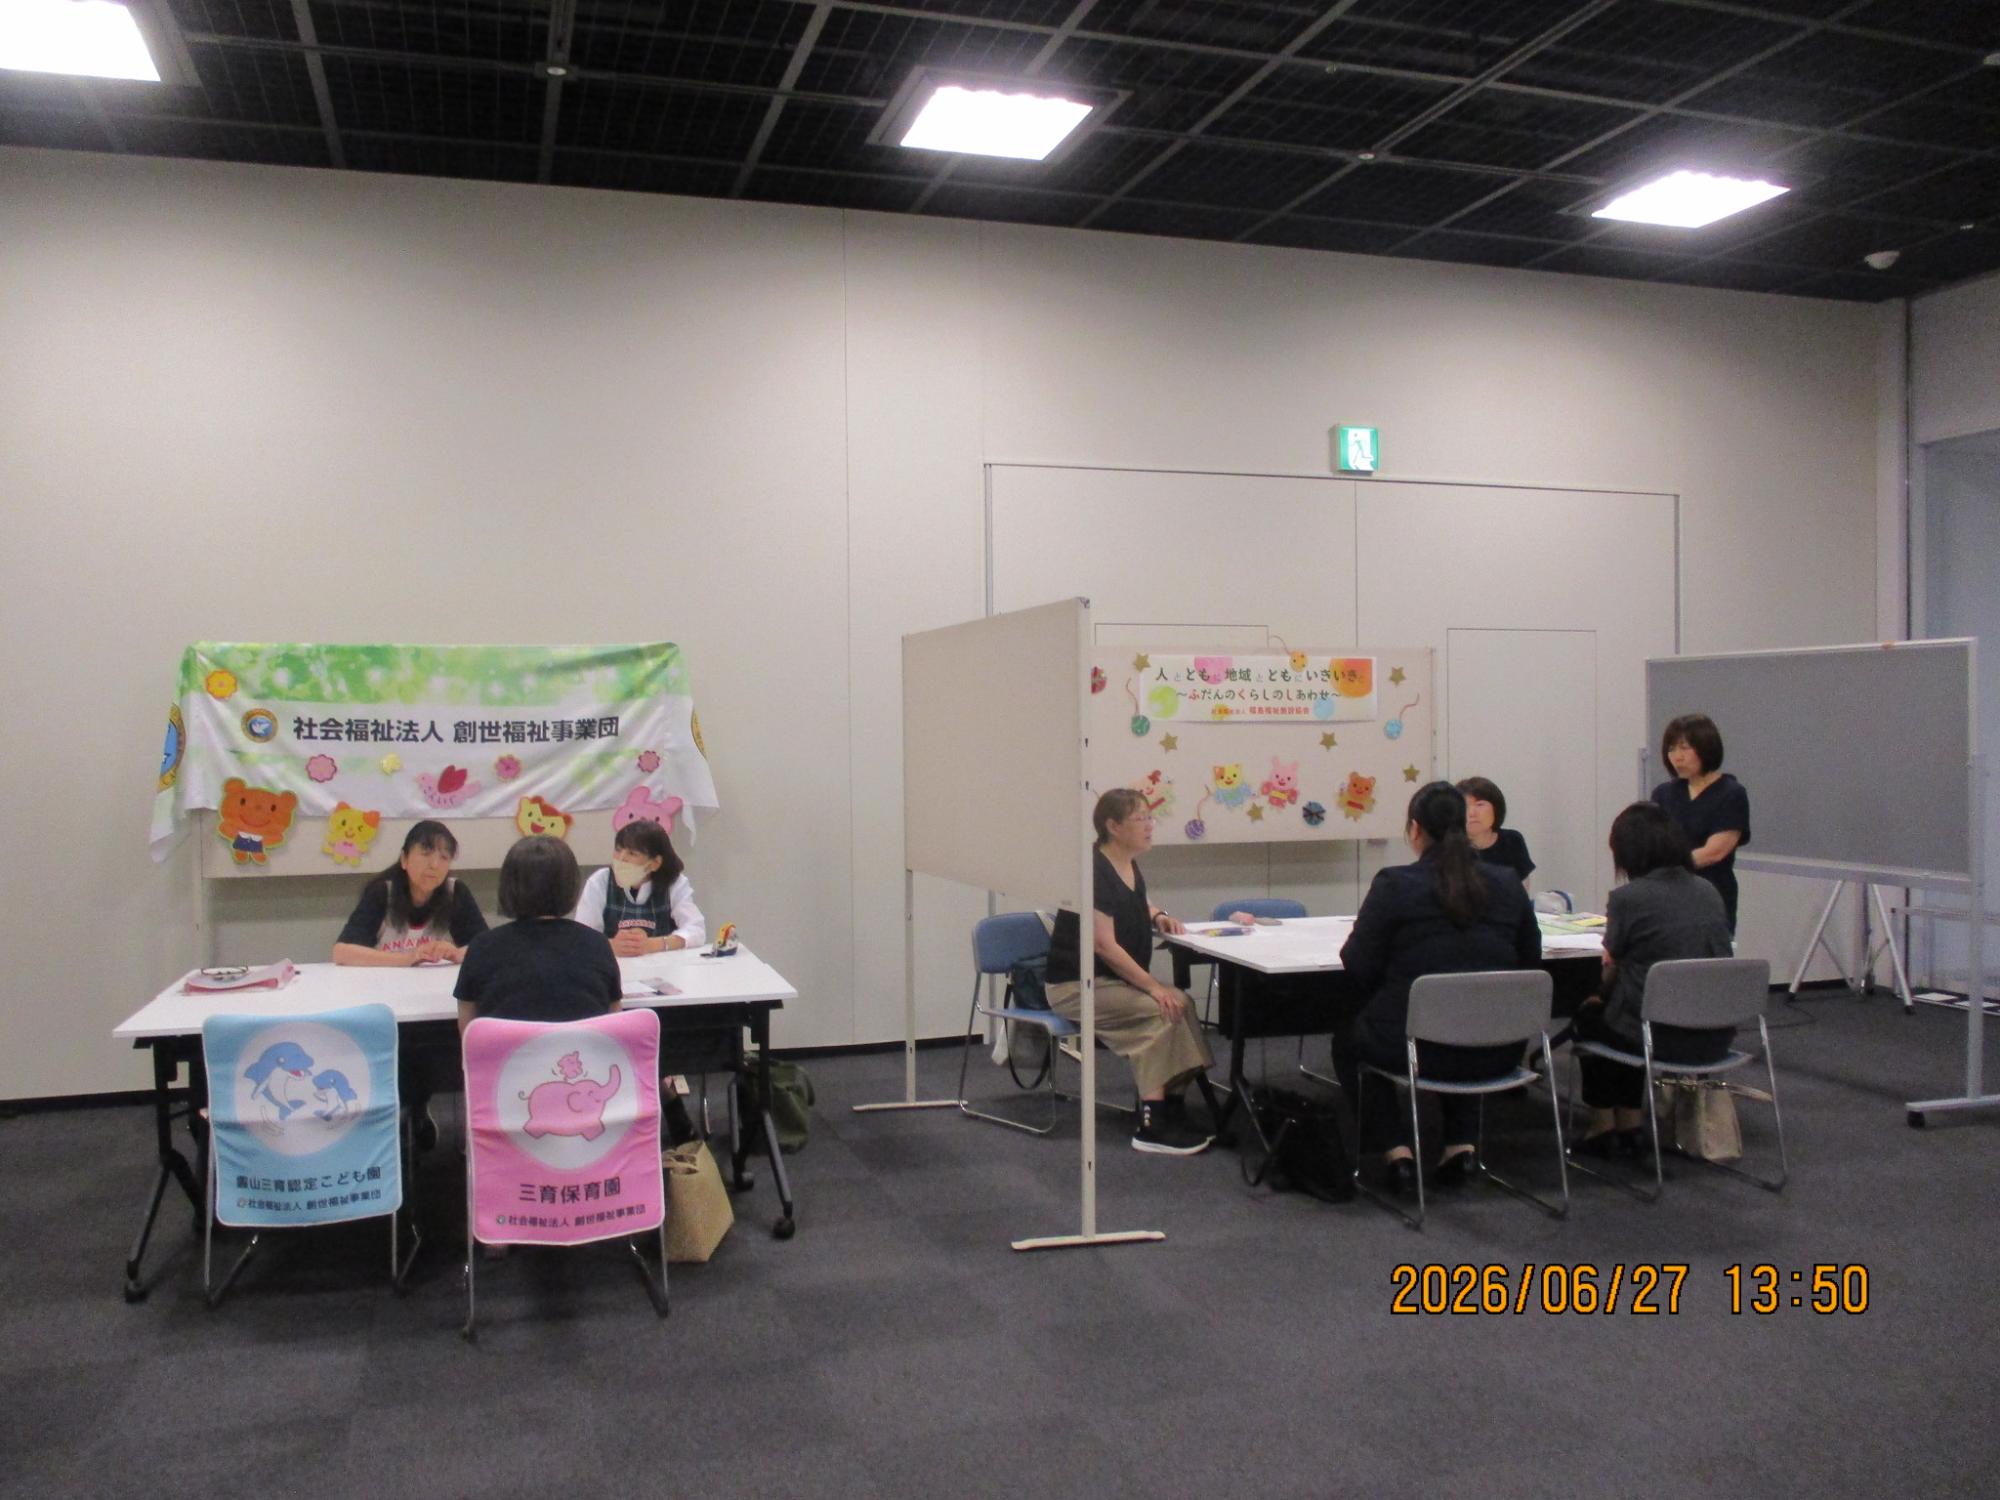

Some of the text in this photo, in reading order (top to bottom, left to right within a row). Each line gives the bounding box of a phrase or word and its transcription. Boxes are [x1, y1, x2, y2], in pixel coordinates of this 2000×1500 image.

[293, 716, 619, 743] 社会福祉法人 創世福祉事業団
[519, 1176, 621, 1204] 三育保育園
[508, 1214, 570, 1228] 社会福祉法人
